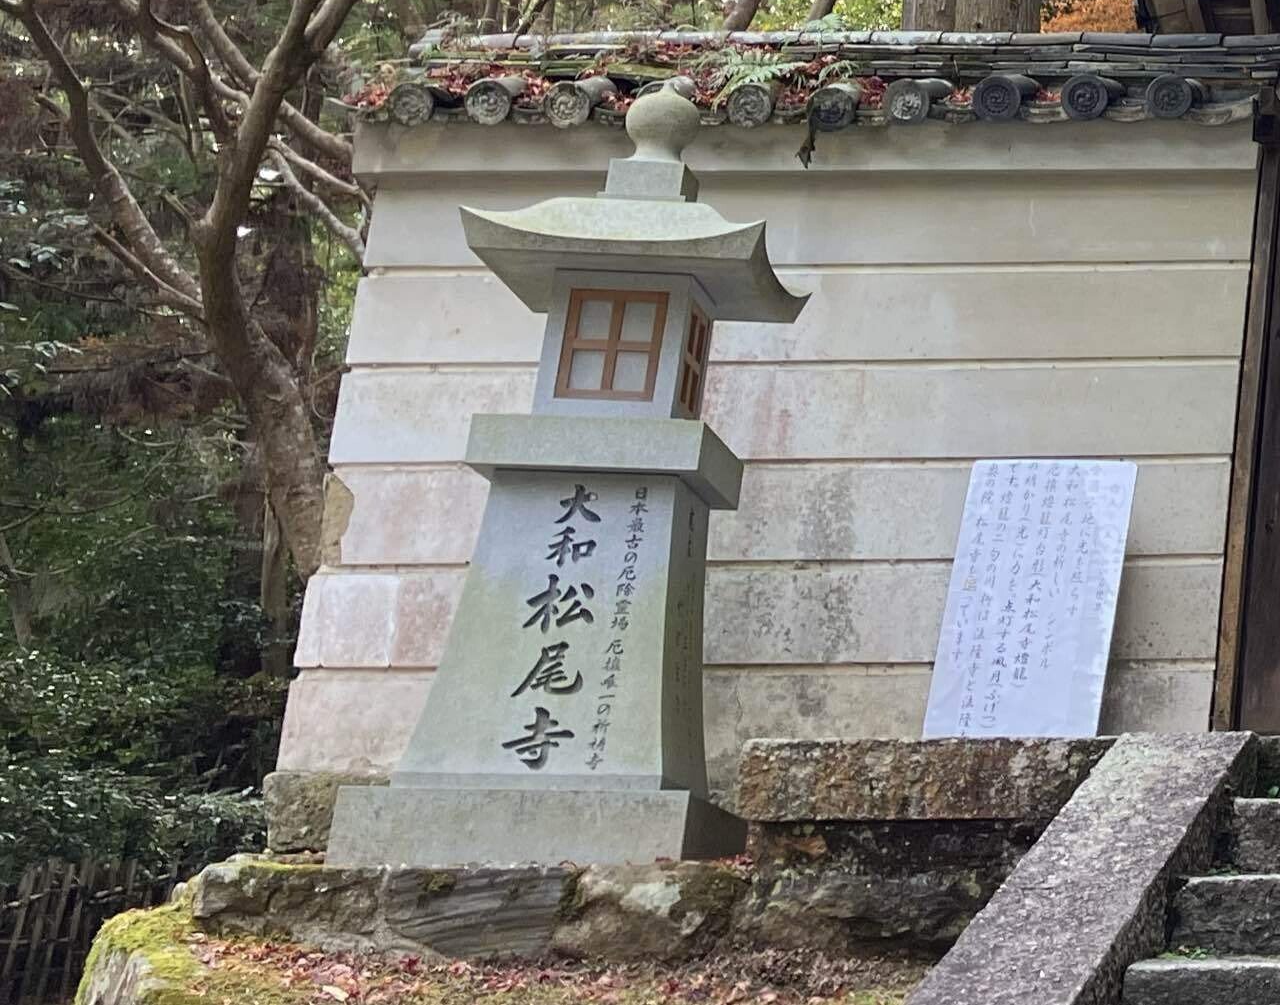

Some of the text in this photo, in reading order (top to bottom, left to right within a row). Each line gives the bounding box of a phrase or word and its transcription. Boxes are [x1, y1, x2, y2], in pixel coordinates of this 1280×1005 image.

[502, 483, 602, 771] 大和松尾寺
